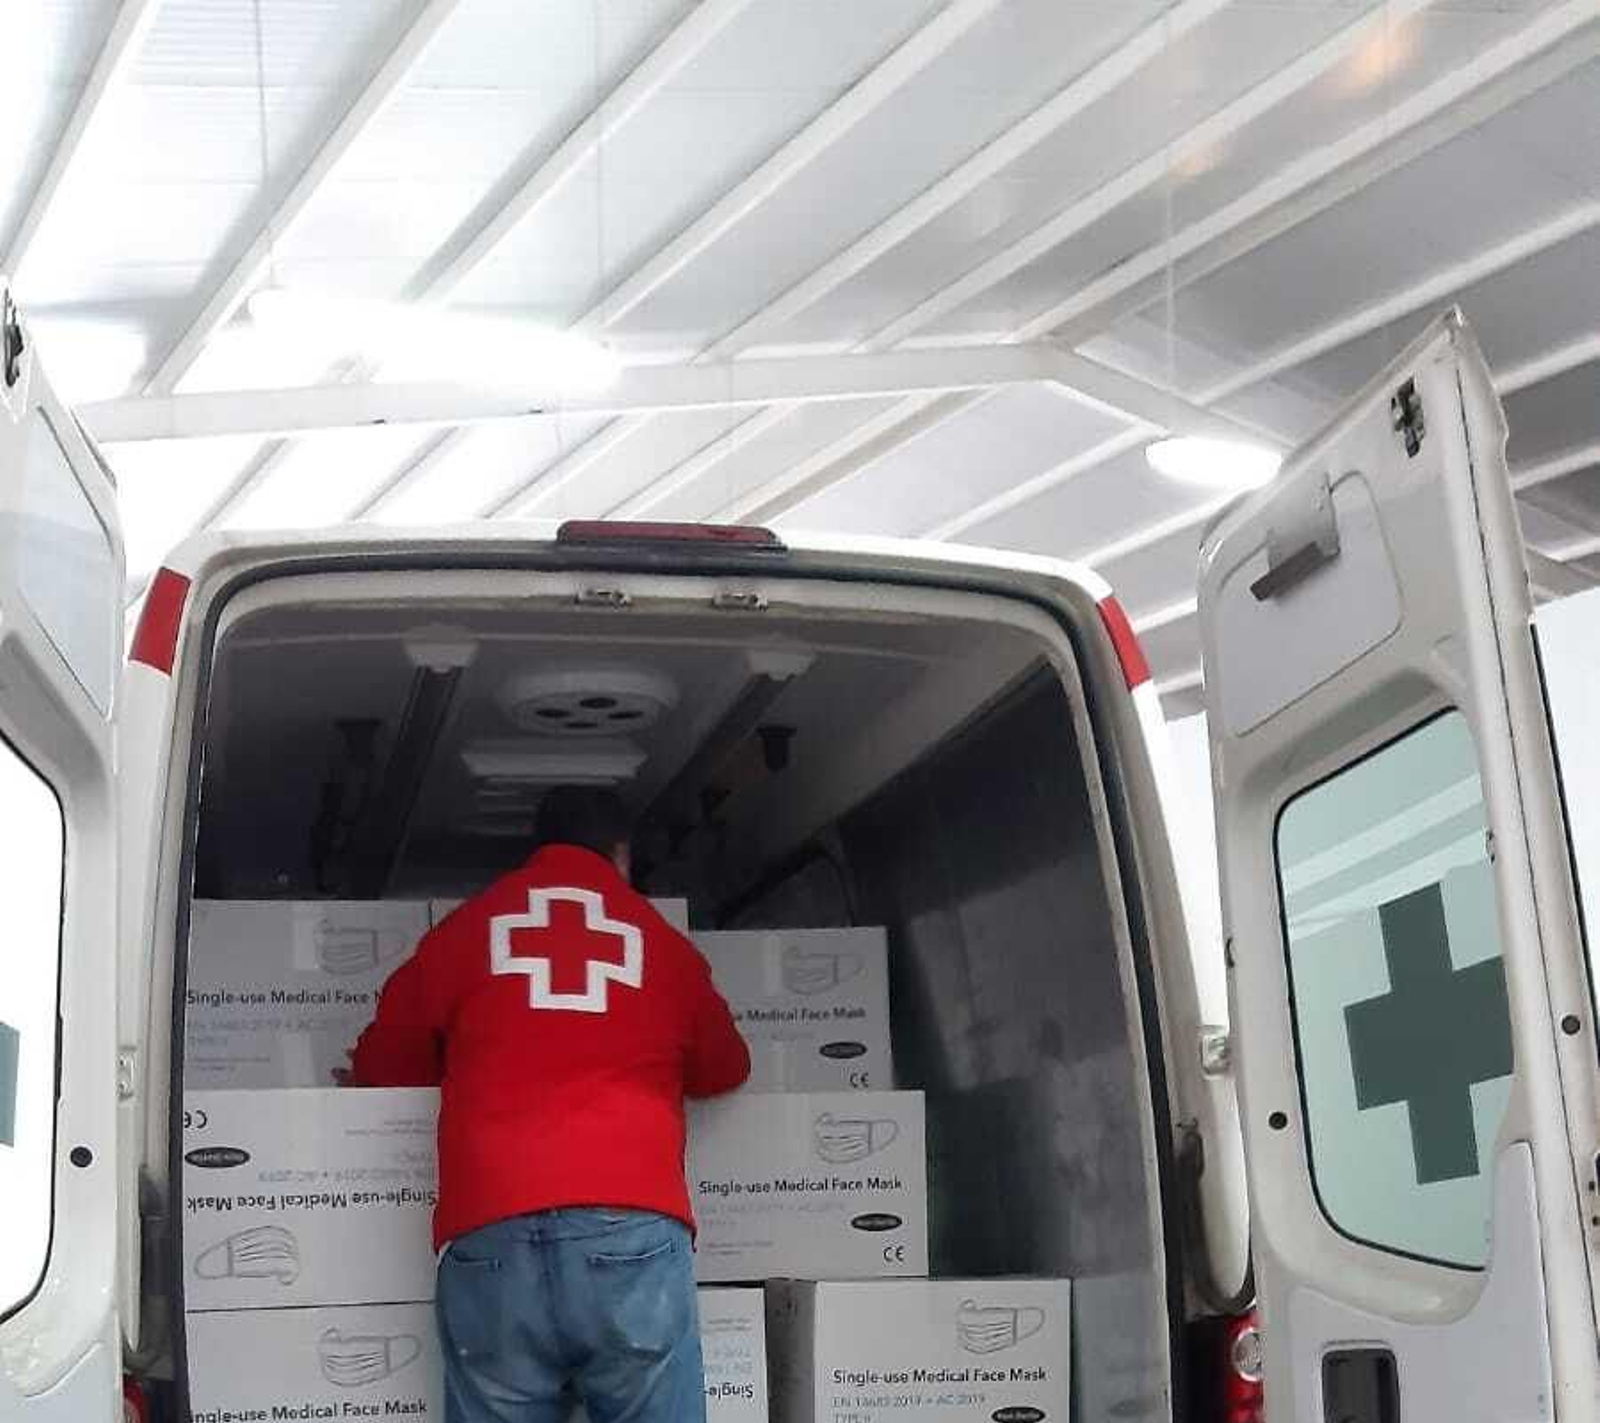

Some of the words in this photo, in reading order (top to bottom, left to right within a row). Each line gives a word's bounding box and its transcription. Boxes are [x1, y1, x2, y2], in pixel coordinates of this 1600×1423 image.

[187, 989, 266, 1008] Single-use
[271, 989, 334, 1005] Medical
[337, 990, 371, 1004] Face
[746, 1007, 798, 1022] Medical
[801, 1007, 831, 1020] Face
[833, 1006, 867, 1020] Mask
[698, 1180, 771, 1197] Single-use
[774, 1177, 828, 1192] Medical
[831, 1177, 863, 1190] Face
[867, 1175, 902, 1190] Mask
[187, 1196, 232, 1214] Mask
[237, 1196, 276, 1211] Face
[280, 1193, 347, 1210] Medical
[353, 1190, 438, 1206] Single-use
[832, 1369, 909, 1387] Single-use
[912, 1368, 970, 1384] Medical
[973, 1369, 1006, 1382] Face
[1009, 1367, 1047, 1382] Mask
[701, 1382, 754, 1401] Single-
[272, 1402, 338, 1420] Medical
[342, 1401, 380, 1417] Face
[385, 1398, 429, 1415] Mask
